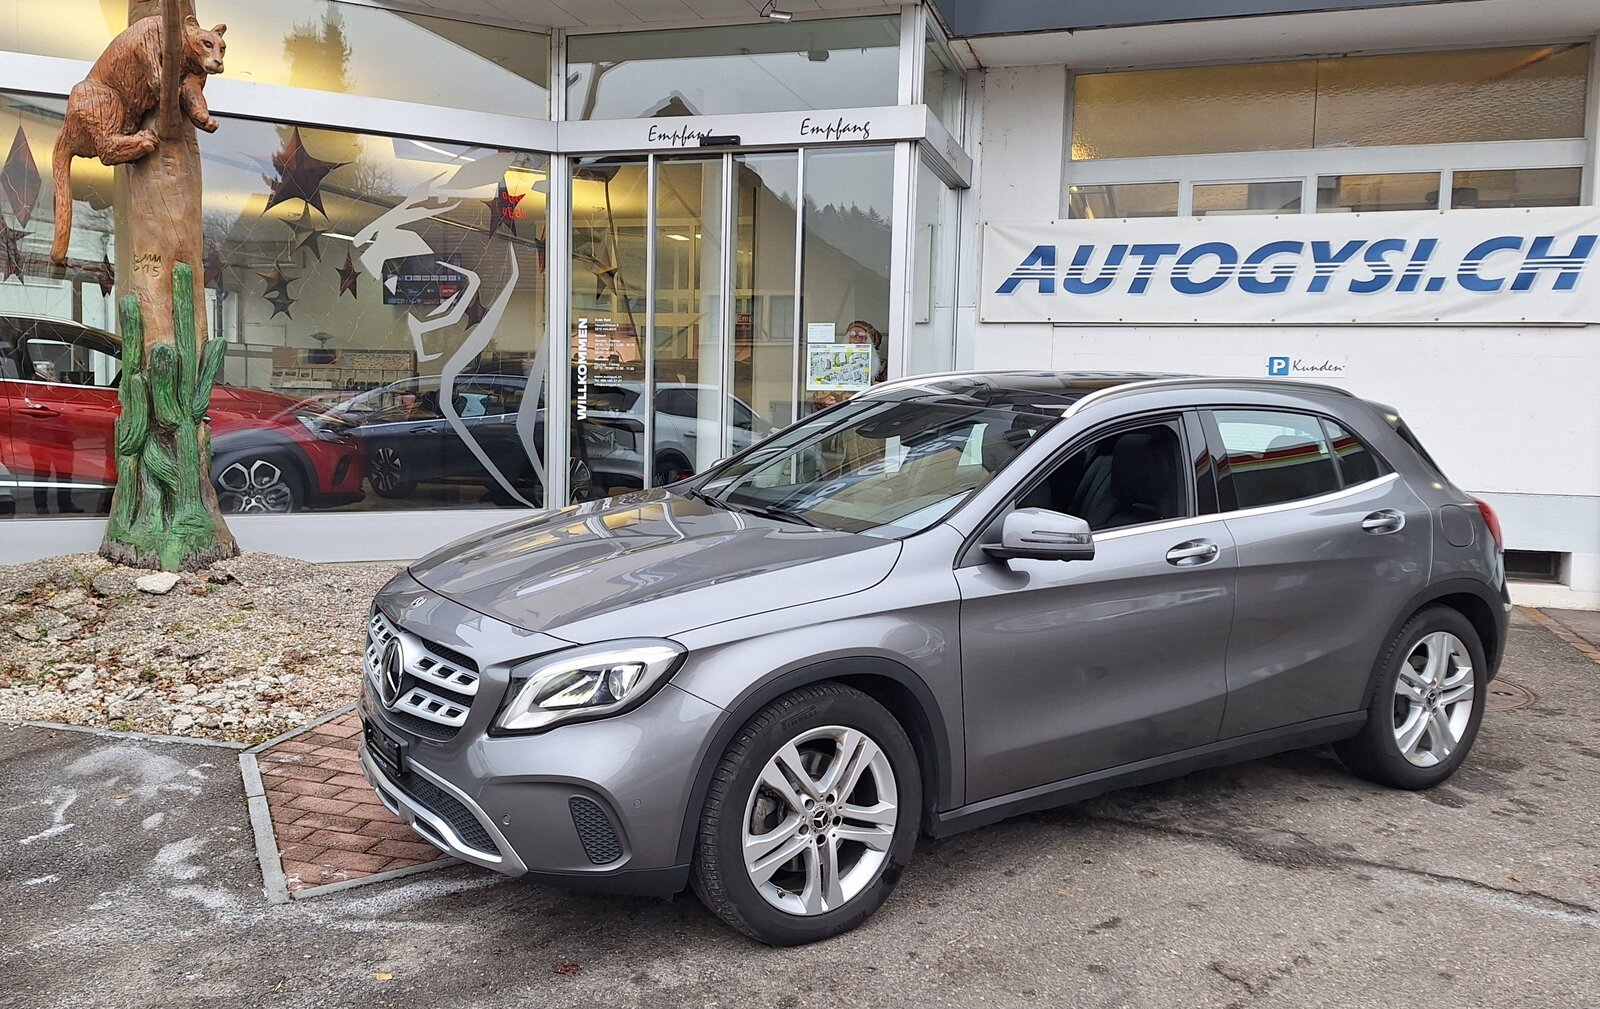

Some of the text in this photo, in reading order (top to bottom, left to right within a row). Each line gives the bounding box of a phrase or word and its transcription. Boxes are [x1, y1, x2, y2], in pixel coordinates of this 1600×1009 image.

[800, 117, 871, 140] Empfang
[995, 235, 1598, 296] AUTOGYSI.CH
[577, 317, 588, 420] WILLKOMMEN
[1292, 359, 1343, 372] Kunden
